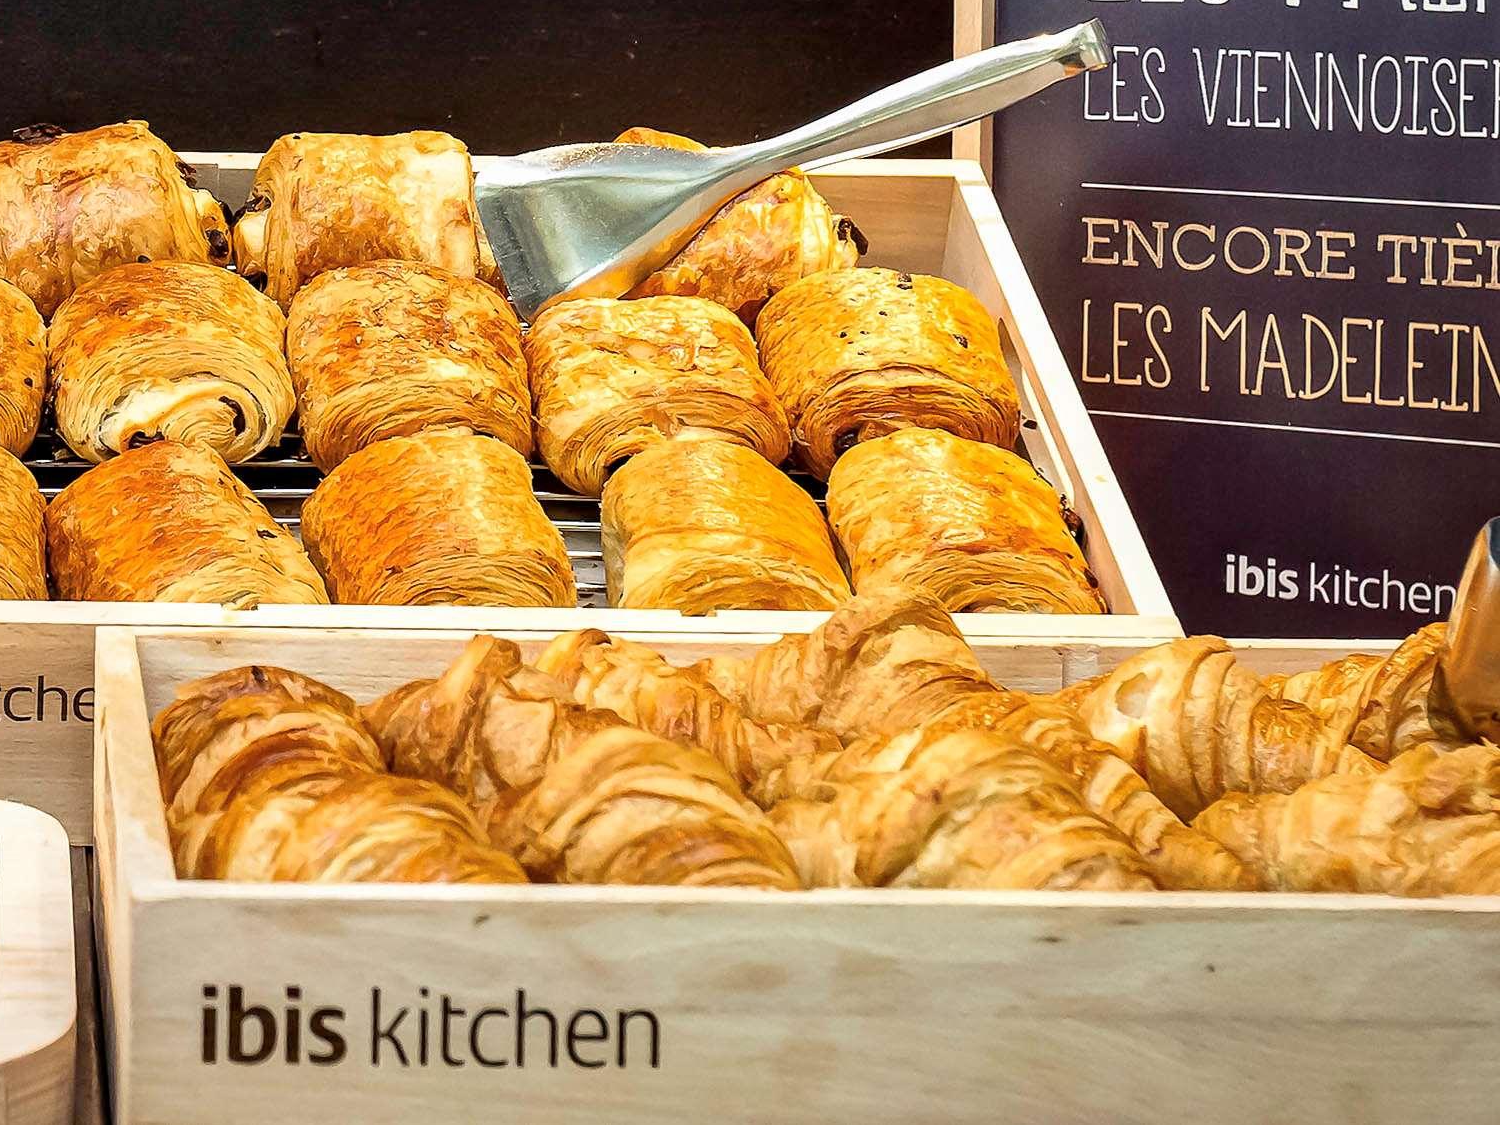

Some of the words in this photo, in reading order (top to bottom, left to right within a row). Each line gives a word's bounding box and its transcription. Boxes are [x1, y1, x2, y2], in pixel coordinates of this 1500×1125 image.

[1083, 45, 1166, 123] LES
[1192, 47, 1500, 139] VIENNOISE
[1081, 217, 1356, 280] ENCORE
[1082, 299, 1172, 388] LES
[1226, 553, 1299, 600] ibis
[1309, 562, 1457, 615] kitchen
[201, 984, 347, 1066] ibis
[371, 987, 660, 1069] kitchen
